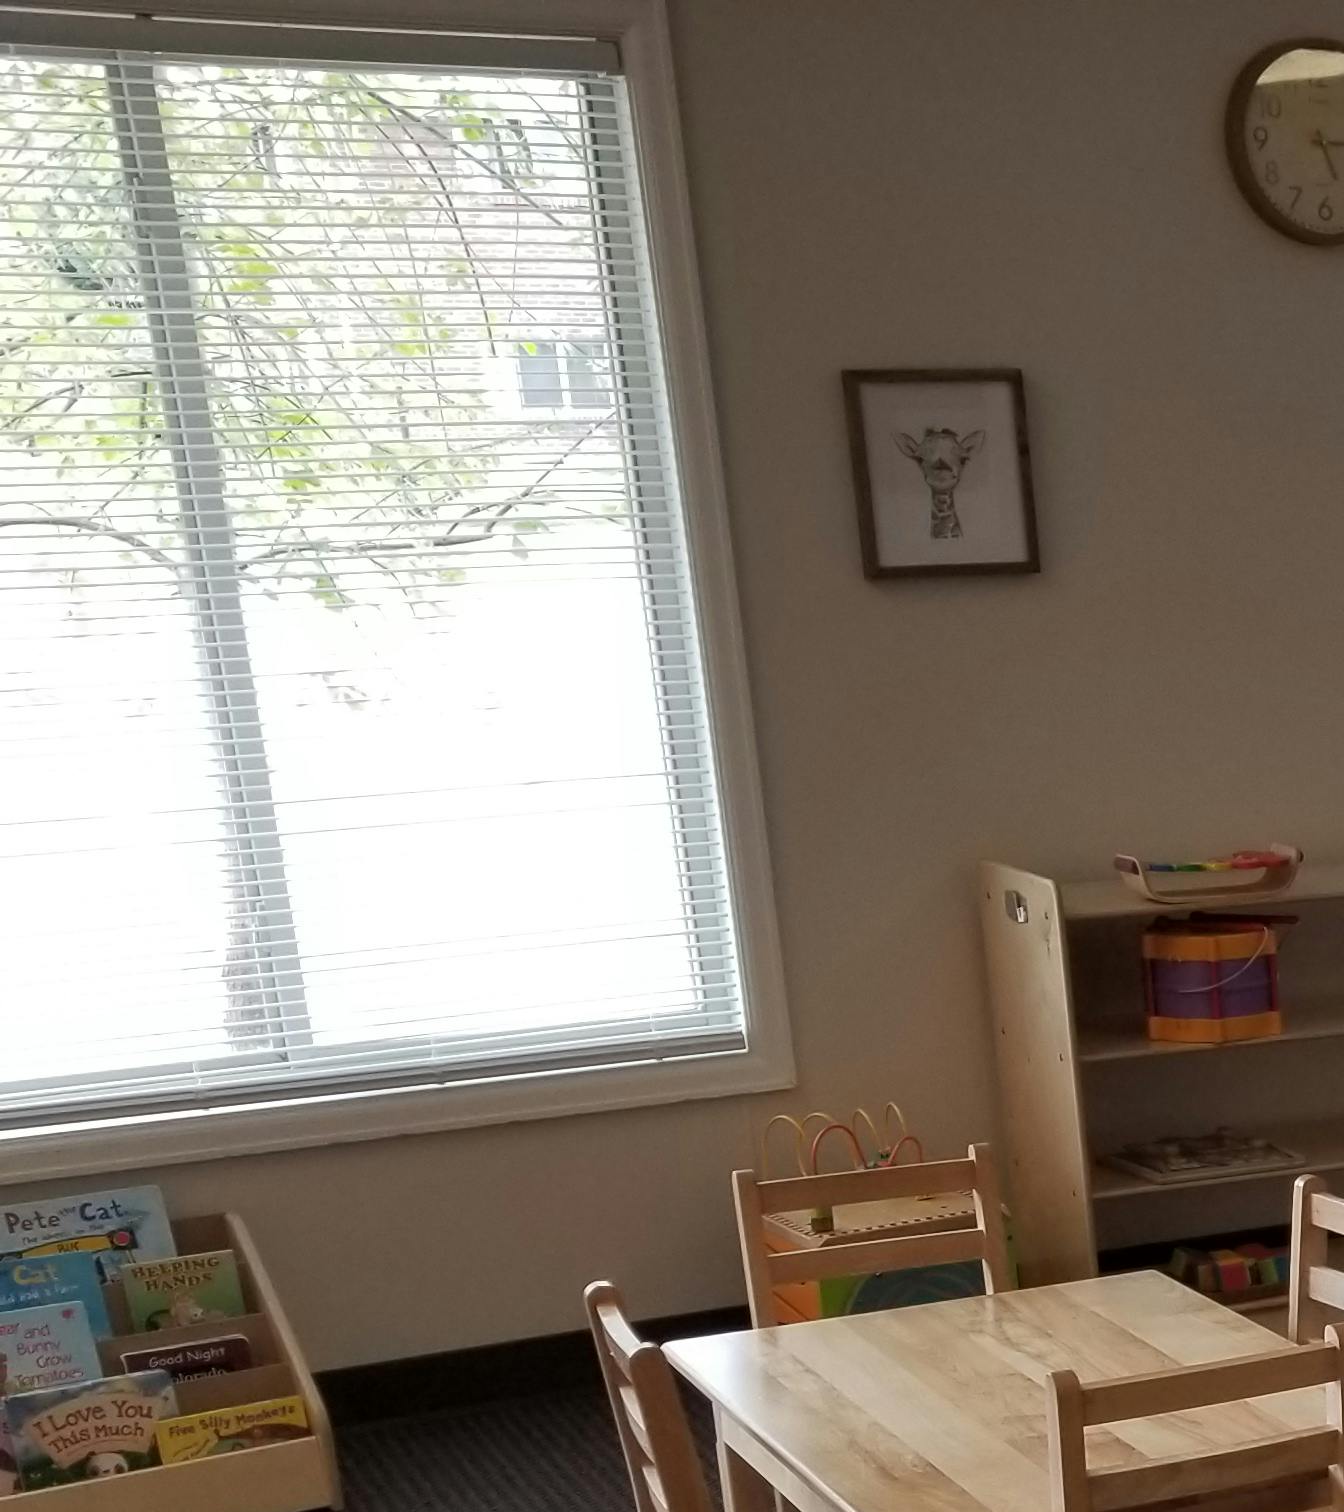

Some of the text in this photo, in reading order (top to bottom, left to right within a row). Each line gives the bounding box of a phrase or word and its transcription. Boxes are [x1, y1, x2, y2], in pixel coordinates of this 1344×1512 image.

[1252, 126, 1268, 151] 9
[1264, 161, 1280, 185] 8
[1288, 185, 1303, 210] 7
[1318, 196, 1334, 222] 6
[4, 1209, 61, 1234] Pete
[78, 1199, 125, 1222] Cat
[130, 1256, 221, 1279] HELPING
[145, 1272, 214, 1292] HANDS
[24, 1323, 51, 1339] and
[148, 1346, 226, 1369] Good Night
[32, 1421, 50, 1439] I
[46, 1405, 107, 1431] Love
[111, 1399, 153, 1419] You
[168, 1404, 296, 1438] Five Silly Monkeys
[48, 1421, 145, 1454] This Much
